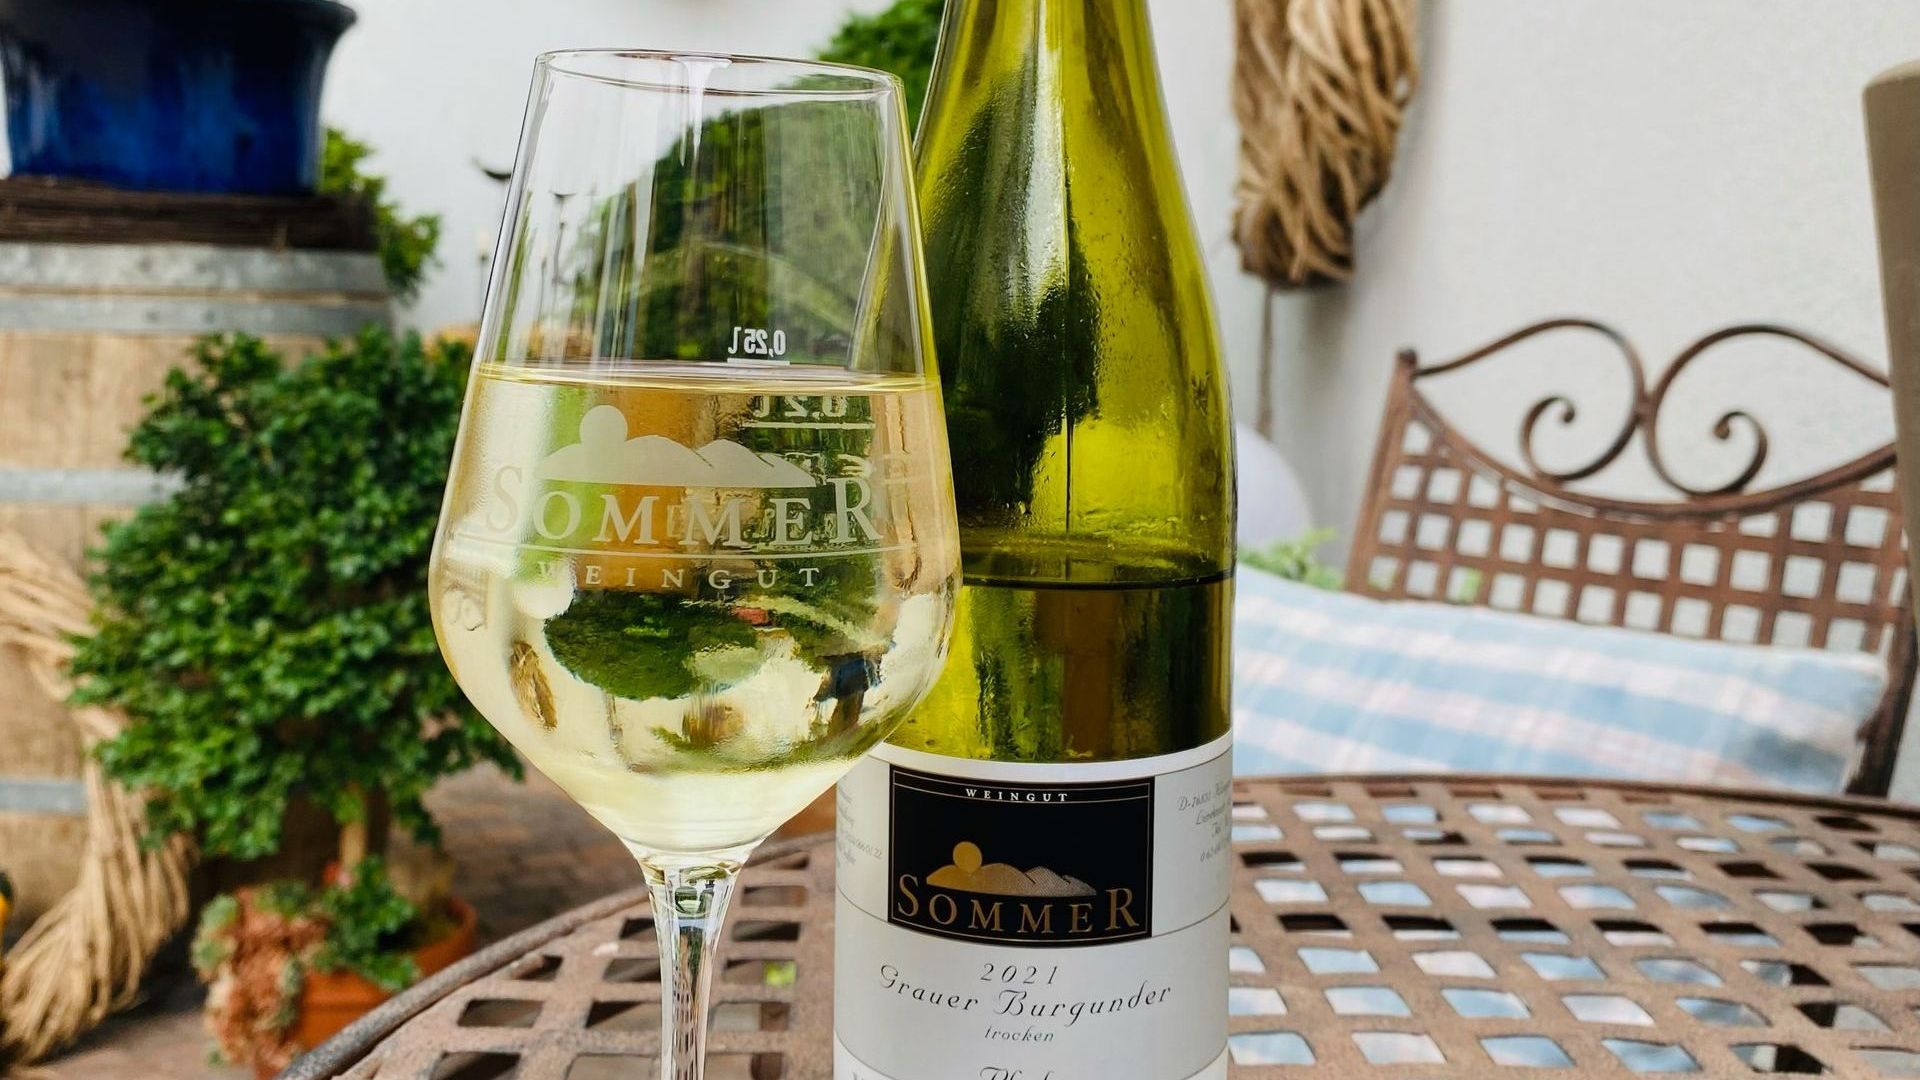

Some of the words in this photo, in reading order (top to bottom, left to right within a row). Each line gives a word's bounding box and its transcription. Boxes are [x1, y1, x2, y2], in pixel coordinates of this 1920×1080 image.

[487, 465, 884, 547] SOMMER
[537, 560, 820, 590] WEINGUT
[966, 788, 1068, 802] WEINGUT
[898, 873, 1140, 935] SOMMER
[980, 963, 1058, 985] 2021
[880, 964, 979, 1012] Grauer
[997, 979, 1172, 1028] Burgunder
[984, 1025, 1055, 1043] trocken
